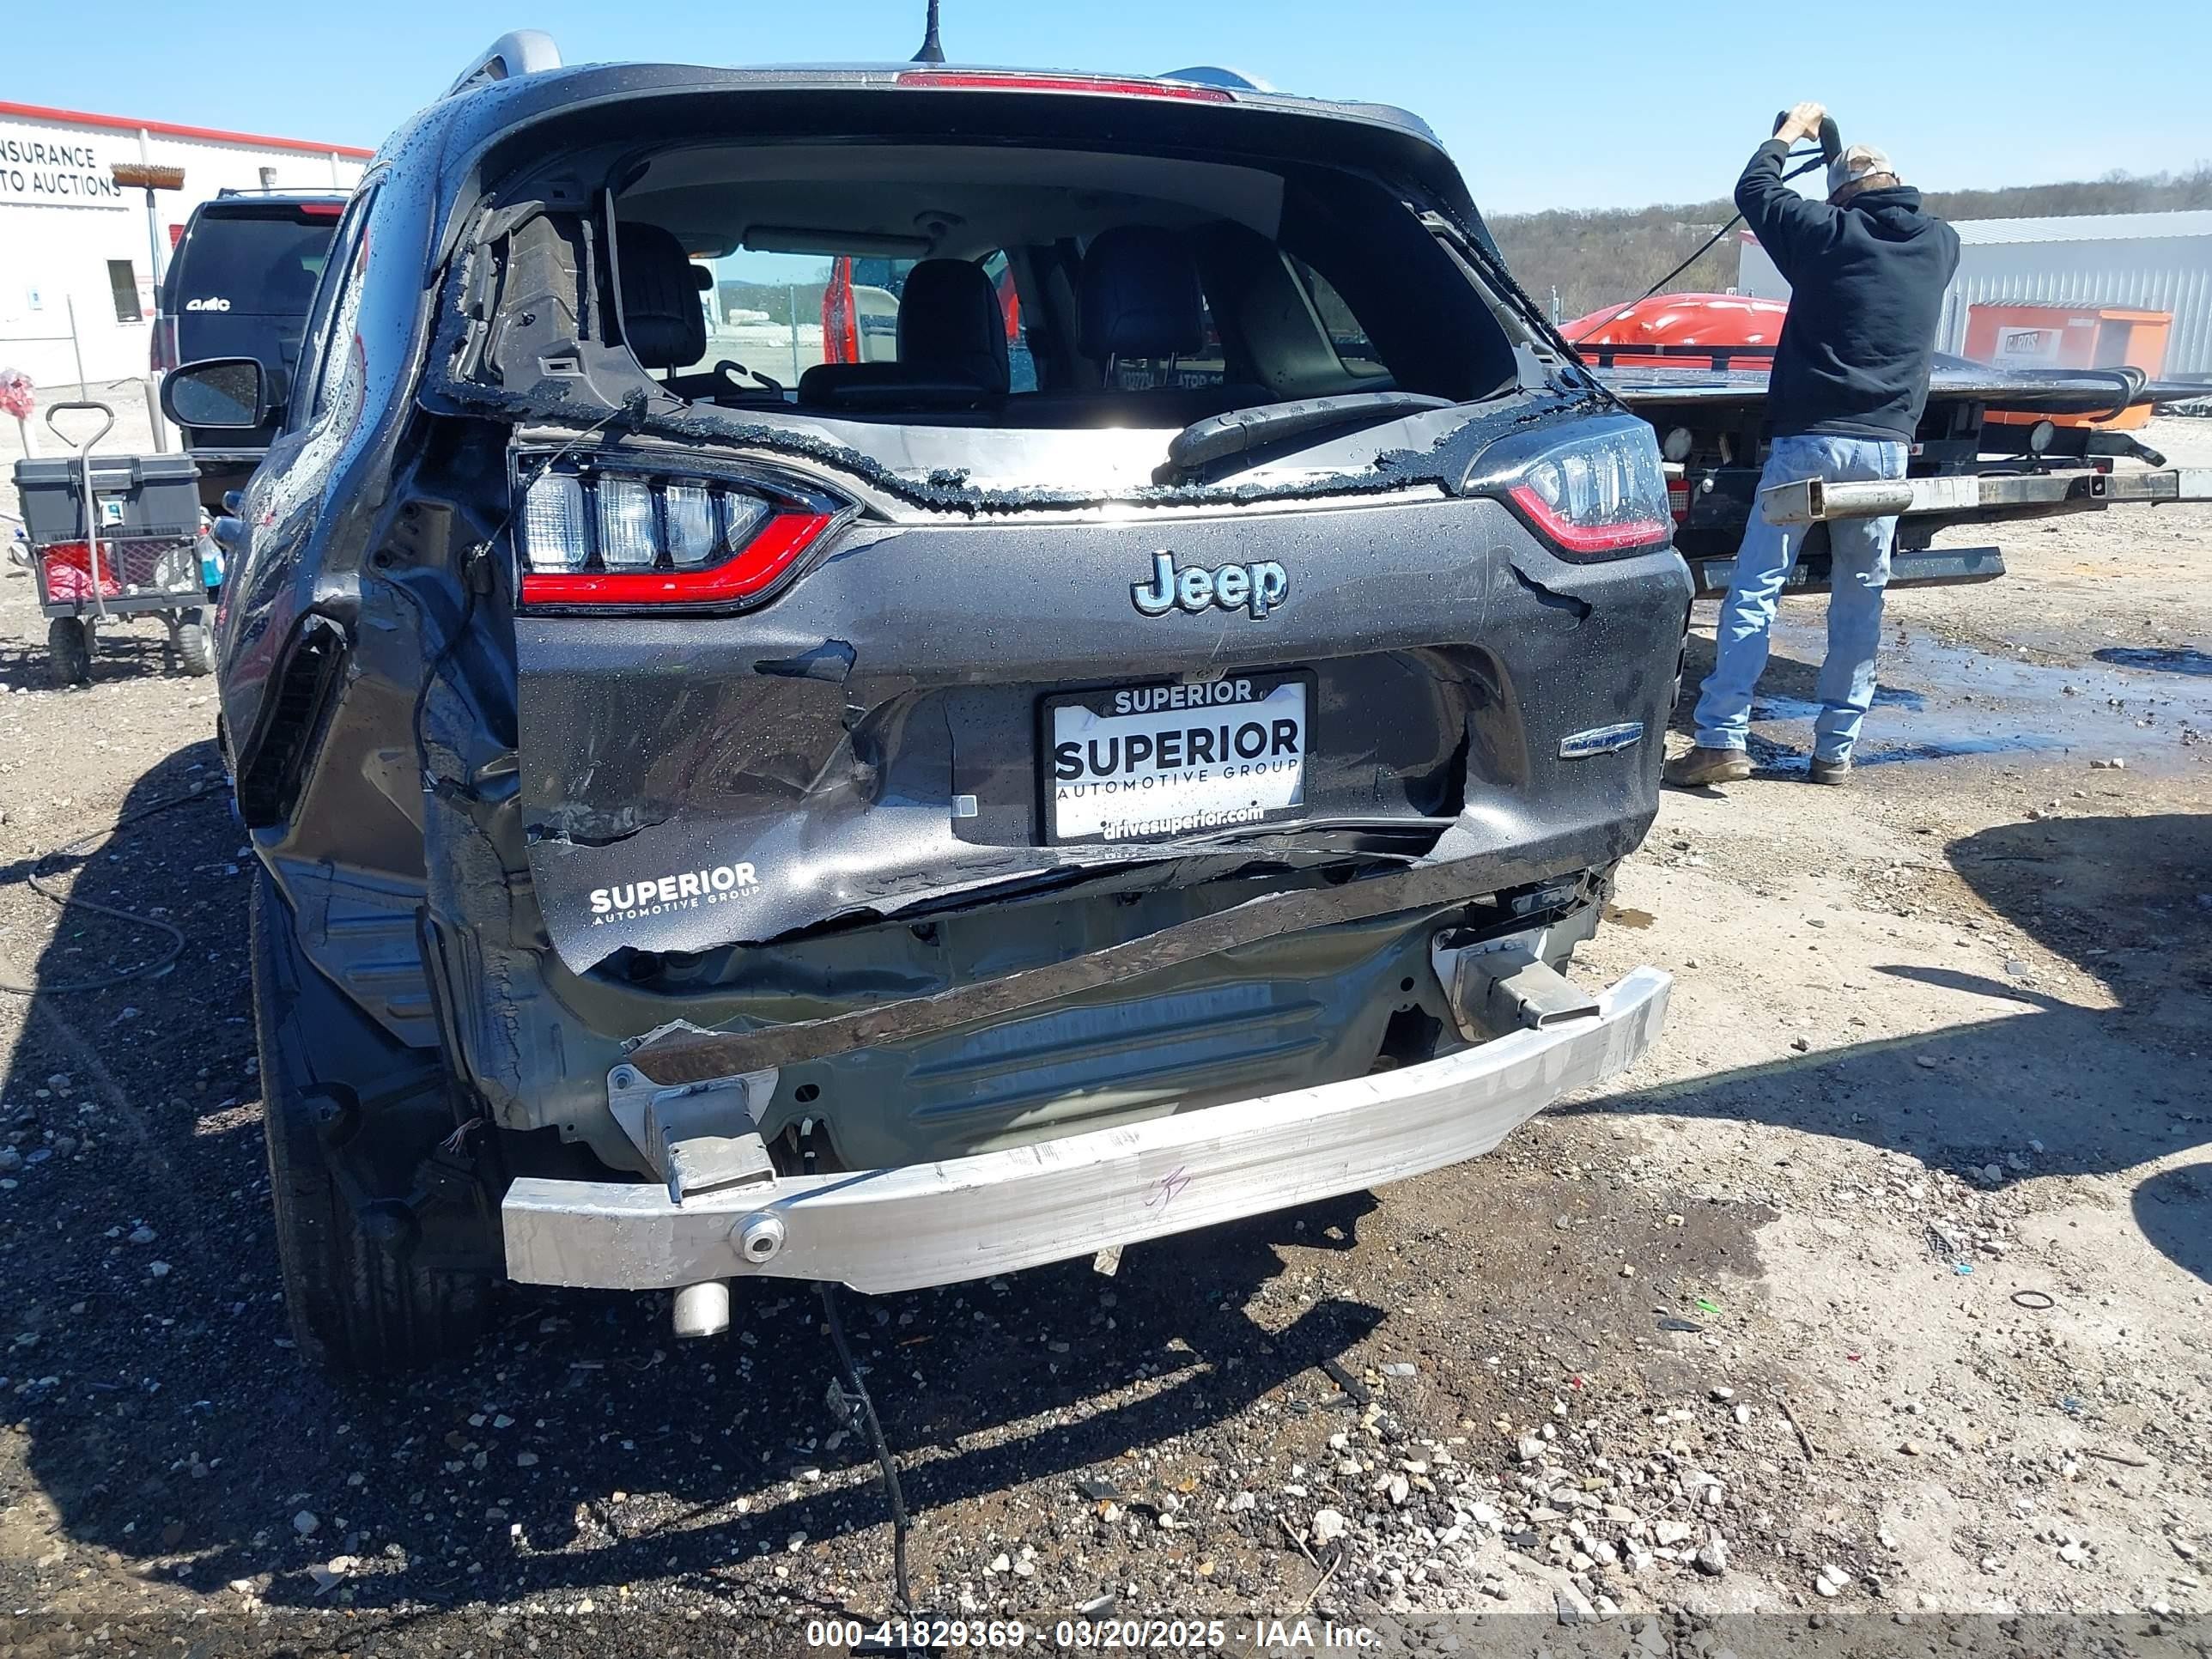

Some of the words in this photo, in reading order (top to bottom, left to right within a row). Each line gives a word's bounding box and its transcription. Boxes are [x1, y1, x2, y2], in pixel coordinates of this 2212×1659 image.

[0, 169, 24, 191] TO
[33, 172, 121, 197] AUCTIONS
[1131, 550, 1288, 621] Jeep
[1115, 679, 1252, 714] SUPERIOR
[1055, 719, 1299, 781] SUPERIOR
[1057, 769, 1209, 800] AUTOMOTIVE
[1223, 758, 1298, 779] GROUP
[1103, 804, 1265, 841] drivesuperior.com
[590, 862, 759, 914] SUPERIOR
[592, 897, 700, 926] AUTOMOTIVE
[708, 885, 761, 904] GROUP
